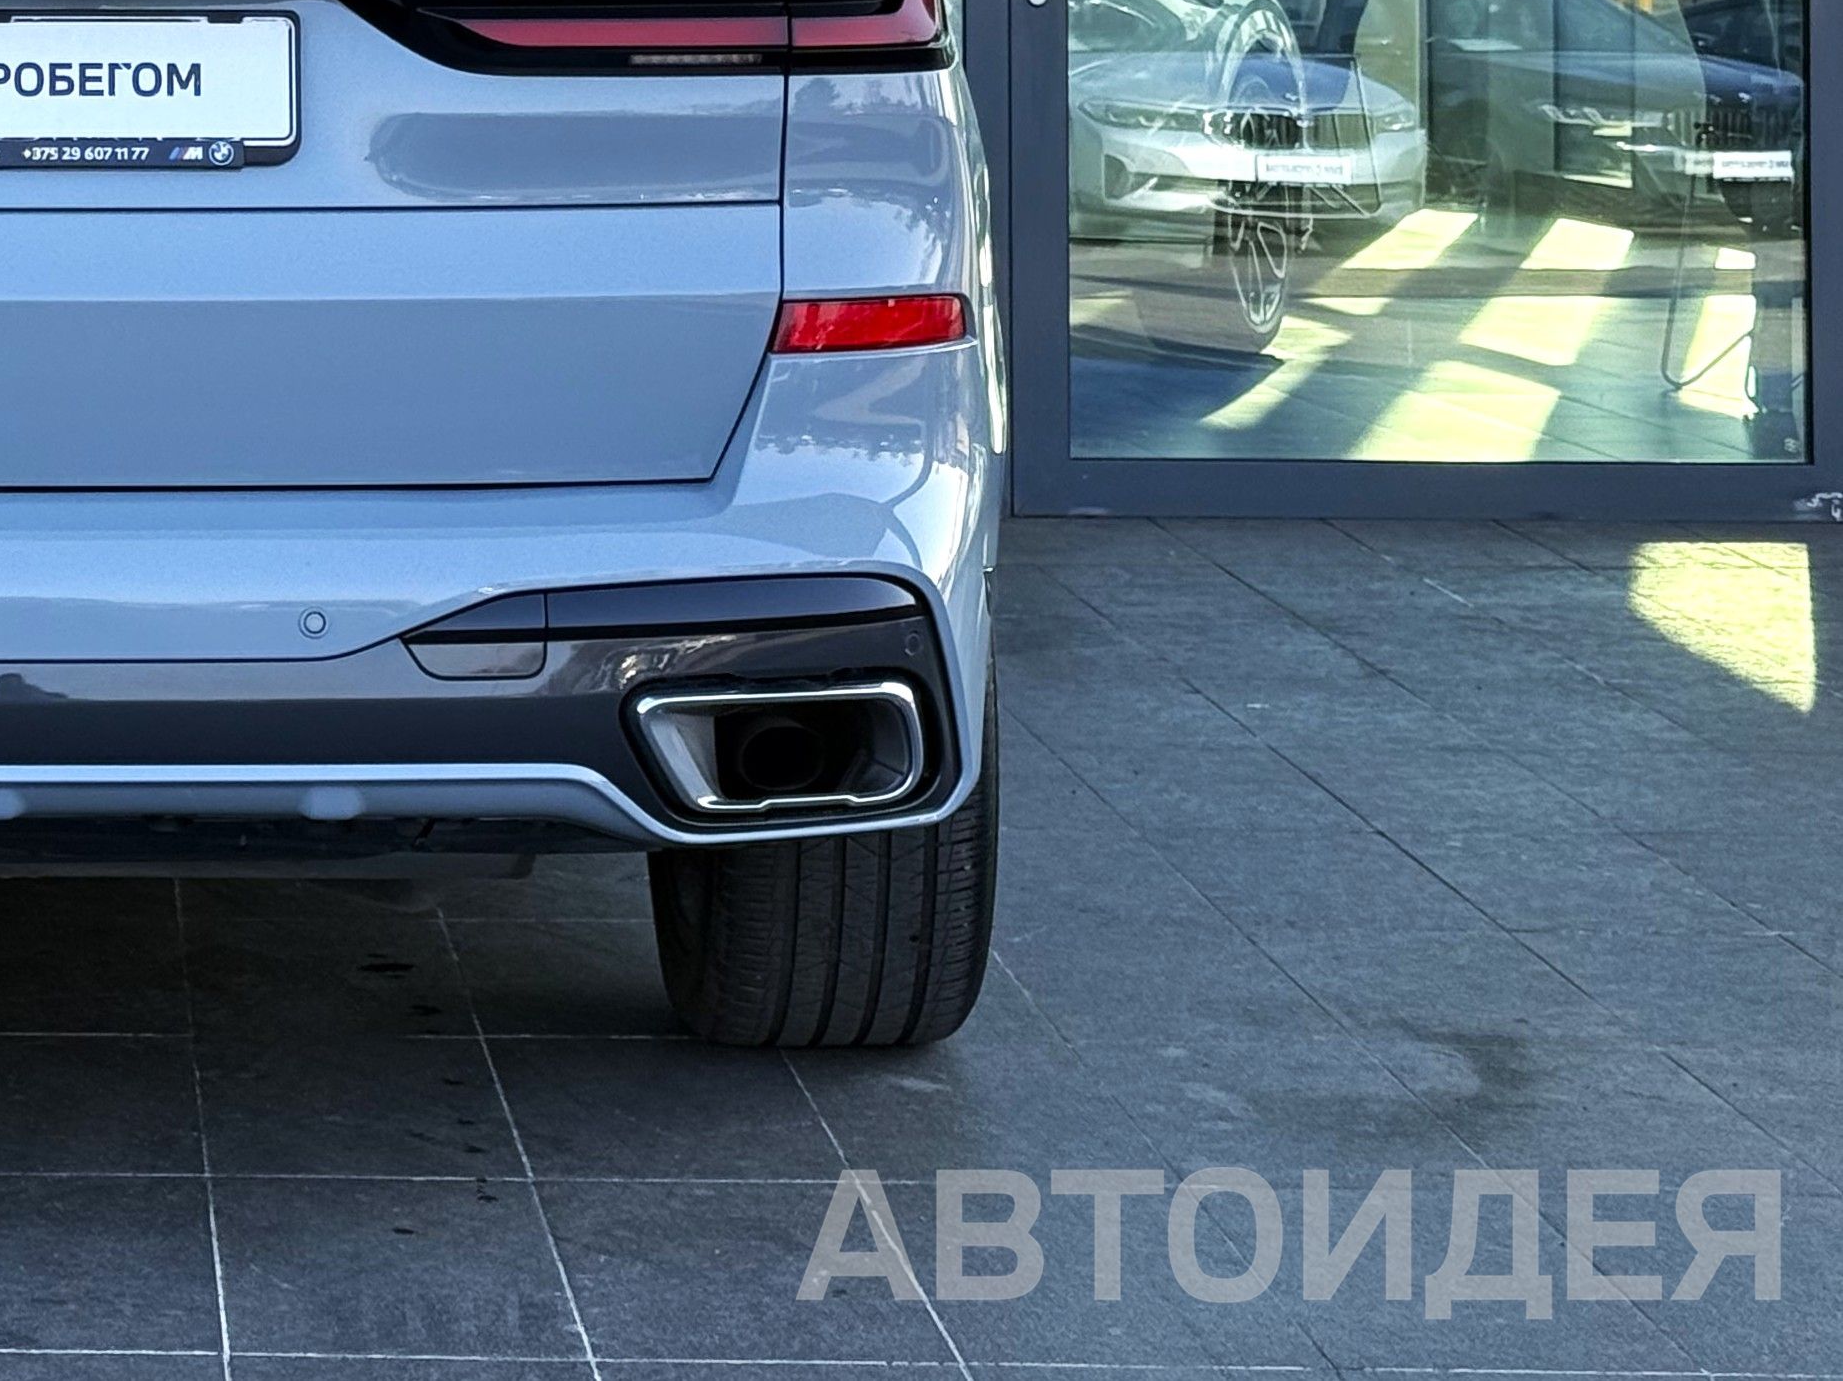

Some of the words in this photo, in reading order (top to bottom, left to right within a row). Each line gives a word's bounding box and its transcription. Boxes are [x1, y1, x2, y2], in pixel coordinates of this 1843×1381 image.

[61, 146, 82, 161] 29
[83, 146, 112, 161] 607
[114, 146, 129, 161] 11
[130, 146, 150, 161] 77
